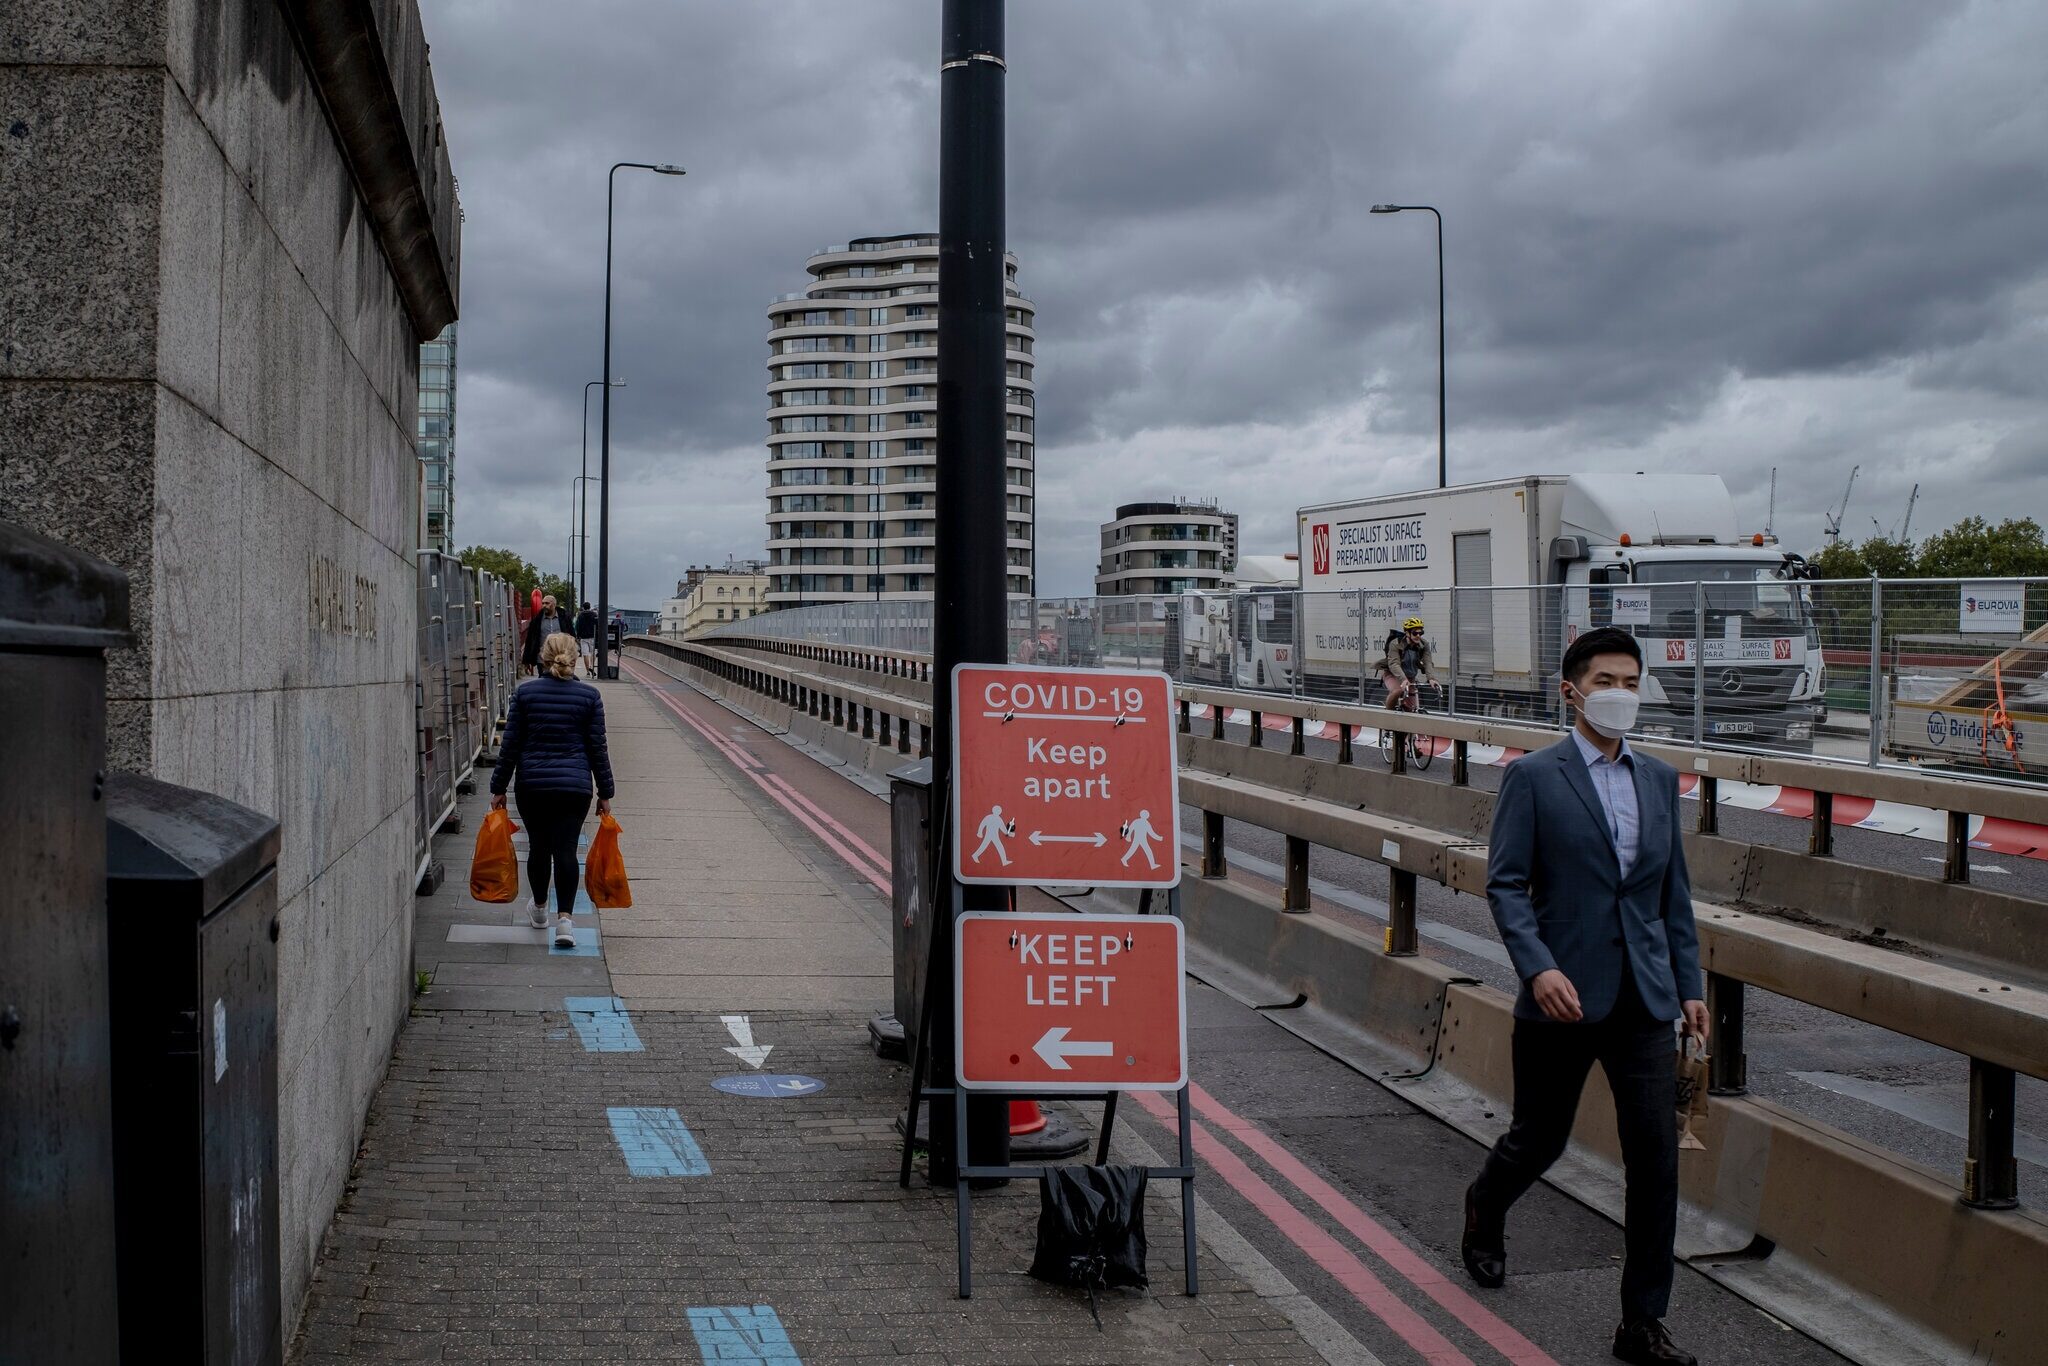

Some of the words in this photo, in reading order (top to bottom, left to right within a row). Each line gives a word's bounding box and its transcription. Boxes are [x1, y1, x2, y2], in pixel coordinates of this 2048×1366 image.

[1340, 525, 1381, 545] SPECIALIST
[1385, 521, 1422, 541] SURFACE
[1336, 546, 1389, 566] PREPARATION
[1392, 543, 1427, 562] LIMITED
[1977, 601, 2019, 610] EUROVIA
[984, 681, 1144, 714] COVID-19
[1027, 737, 1107, 770] Keep
[1023, 773, 1111, 803] apart
[1019, 934, 1122, 966] KEEP
[1026, 975, 1116, 1006] LEFT
